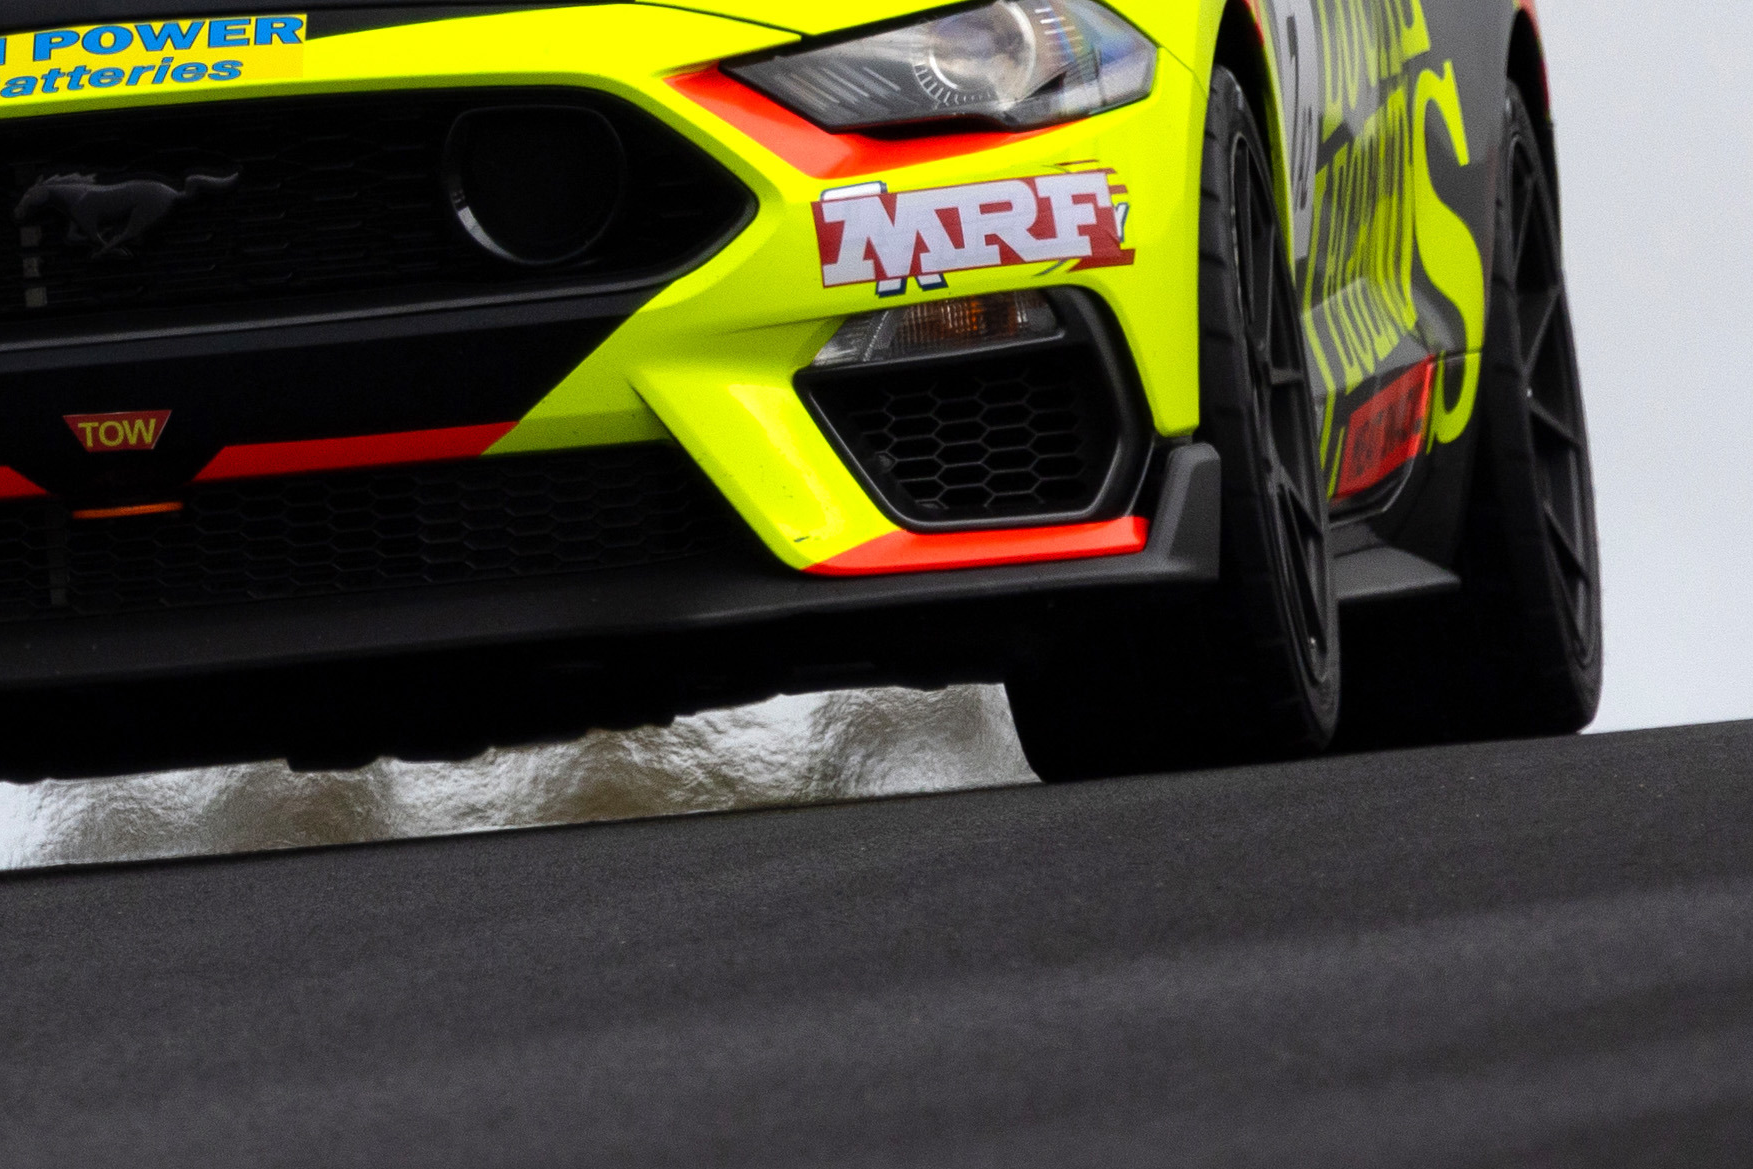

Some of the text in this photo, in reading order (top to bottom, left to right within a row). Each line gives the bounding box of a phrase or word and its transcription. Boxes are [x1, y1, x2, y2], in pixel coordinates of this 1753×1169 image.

[32, 15, 305, 63] POWER
[820, 171, 1113, 288] MRF
[77, 417, 157, 448] TOW
